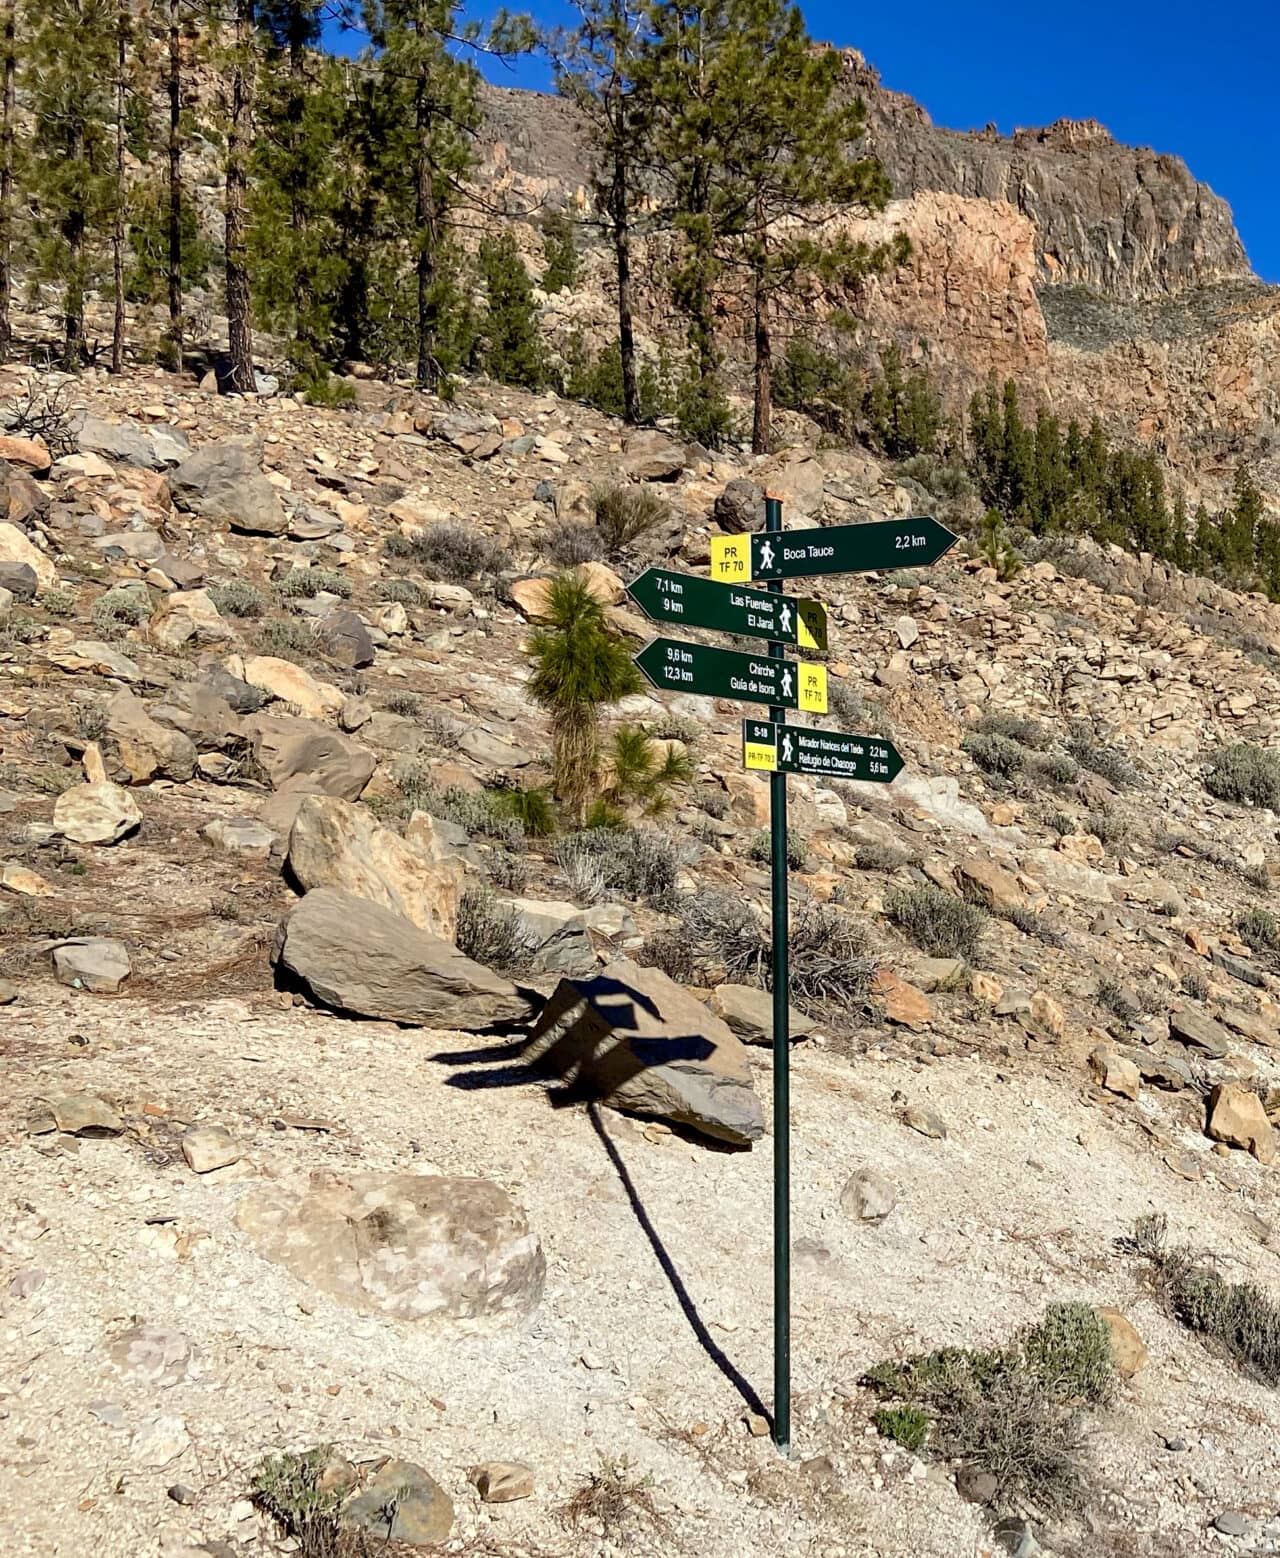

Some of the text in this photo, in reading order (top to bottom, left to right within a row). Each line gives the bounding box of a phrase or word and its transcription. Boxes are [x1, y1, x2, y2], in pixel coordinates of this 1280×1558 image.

[896, 534, 926, 550] 2,2 km
[724, 548, 737, 558] PR
[784, 545, 834, 560] Boca Tauce
[720, 561, 744, 572] TF 70
[656, 577, 683, 594] 7,1 km
[664, 598, 684, 613] 9 km
[730, 592, 774, 613] Las Fuentes
[748, 615, 774, 630] El Jaral
[667, 647, 693, 664] 9,6 km
[664, 666, 694, 682] 12,3 km
[749, 662, 774, 678] Chirche
[730, 677, 776, 696] Guía de Isora
[808, 676, 818, 686] PR
[804, 689, 822, 702] TF 70
[798, 736, 820, 748] Mirador
[841, 742, 850, 752] del
[798, 752, 822, 768] Refugio
[822, 756, 830, 766] de
[880, 748, 888, 758] km
[870, 762, 888, 774] 5,6 km
